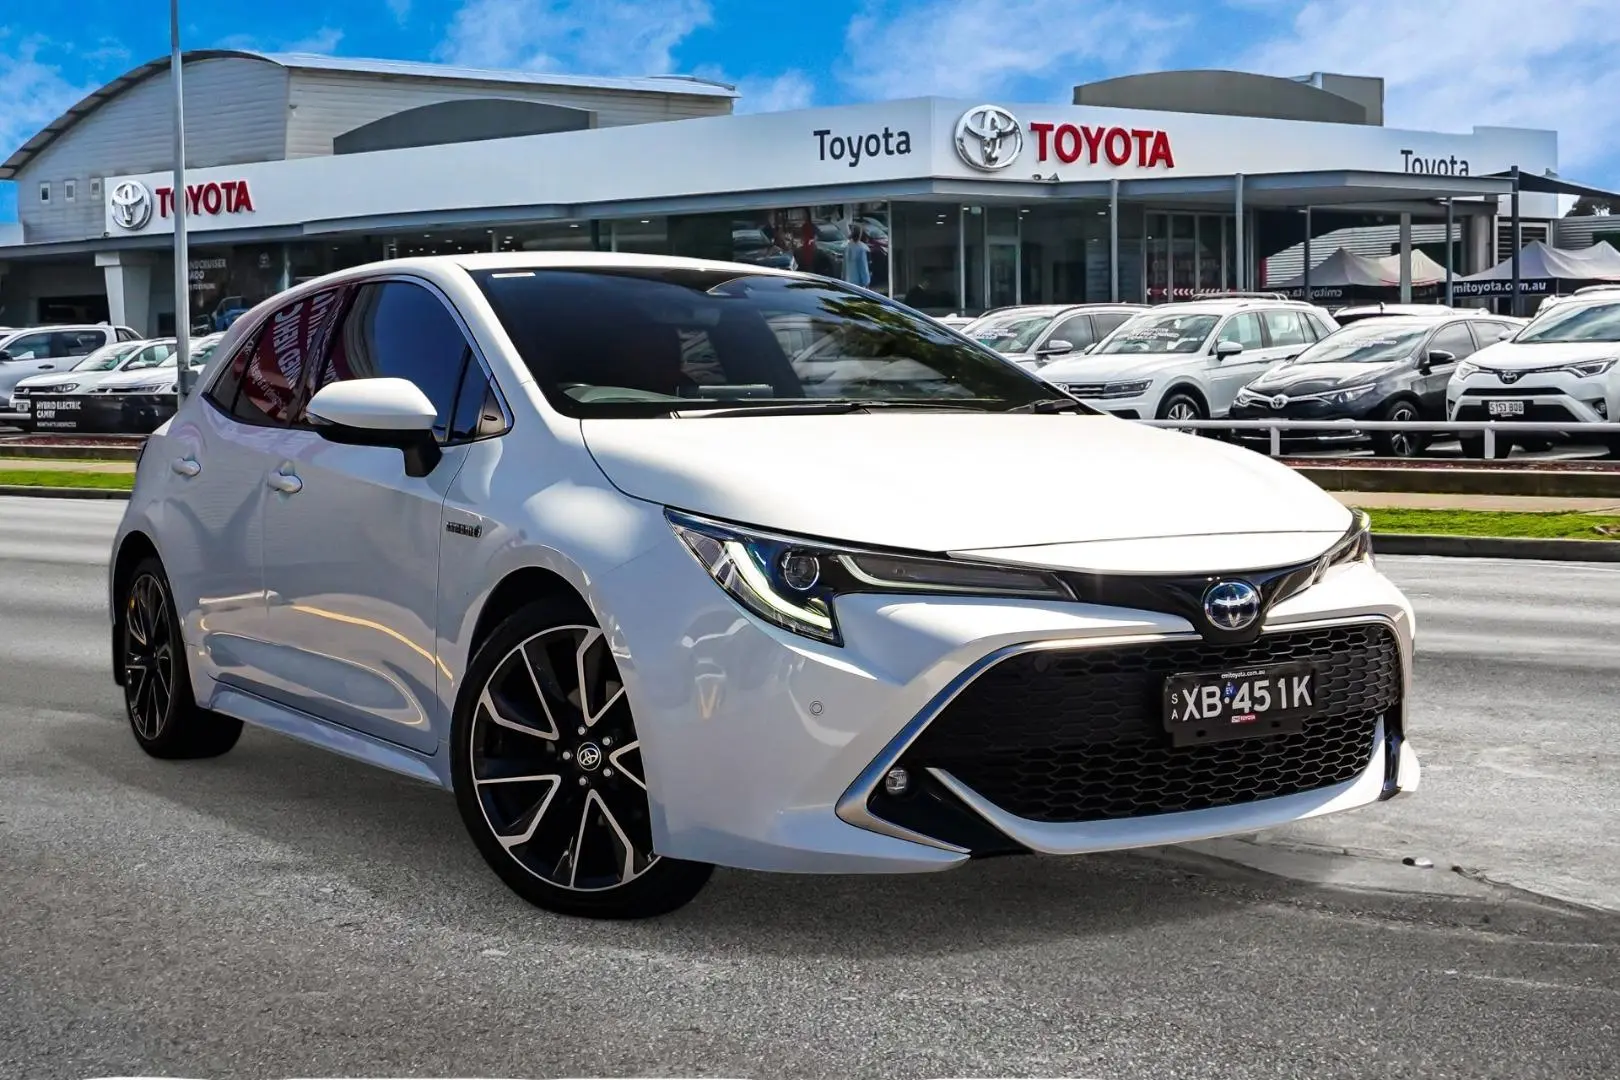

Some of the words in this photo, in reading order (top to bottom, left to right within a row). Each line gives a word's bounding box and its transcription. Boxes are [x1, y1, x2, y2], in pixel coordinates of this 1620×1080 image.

[813, 128, 912, 167] Toyota
[1030, 122, 1175, 168] TOYOTA
[1453, 281, 1547, 295] mitoyota.cm.au
[57, 401, 81, 410] ELECTRIC
